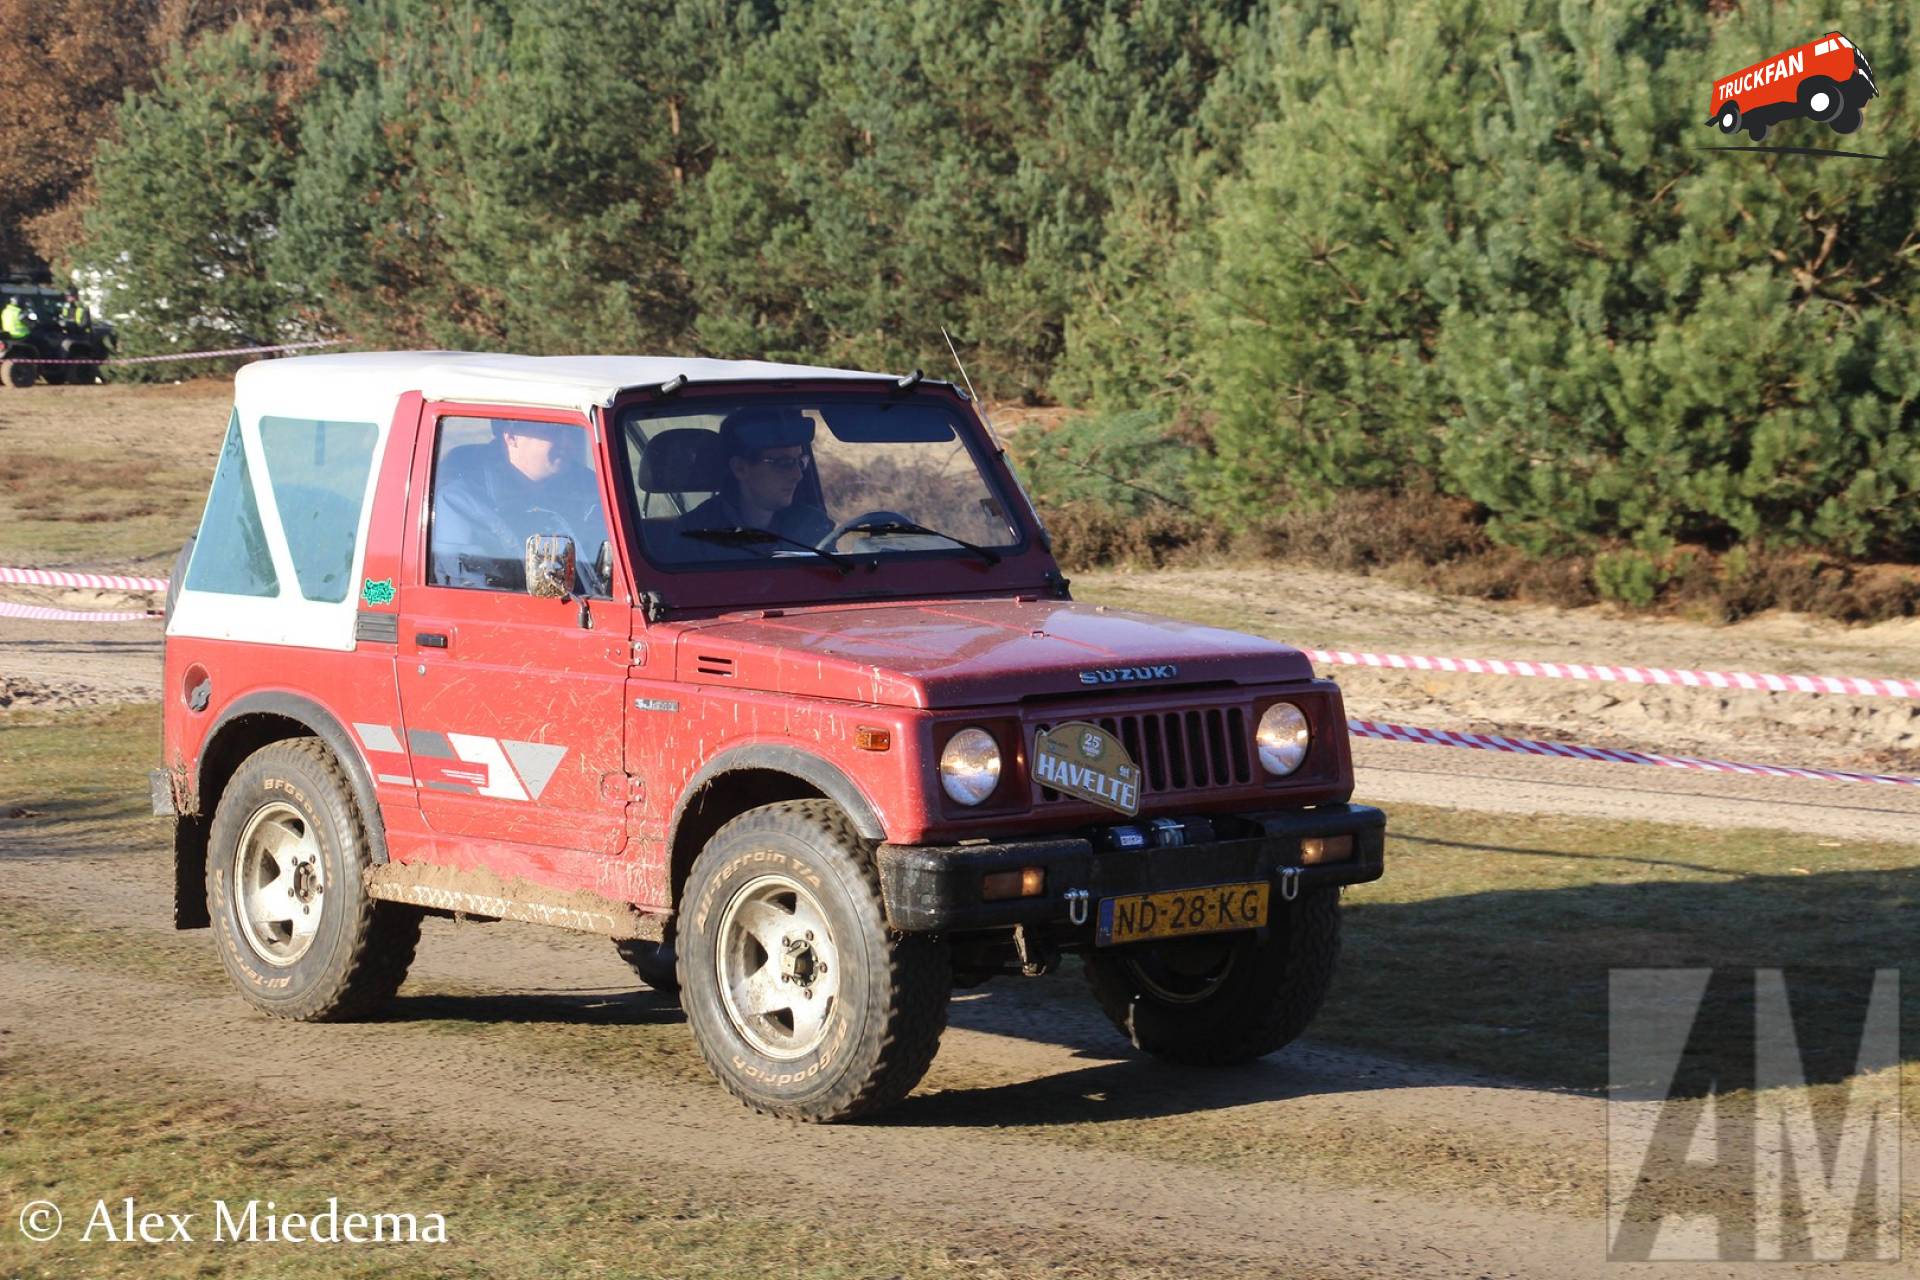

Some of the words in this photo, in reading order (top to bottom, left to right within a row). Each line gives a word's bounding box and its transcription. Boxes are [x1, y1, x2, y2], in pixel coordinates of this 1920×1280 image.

[1079, 664, 1178, 684] SUZUKI
[1084, 733, 1102, 749] 25
[1038, 752, 1136, 810] HAVELTE
[1117, 889, 1259, 937] ND-28-KG
